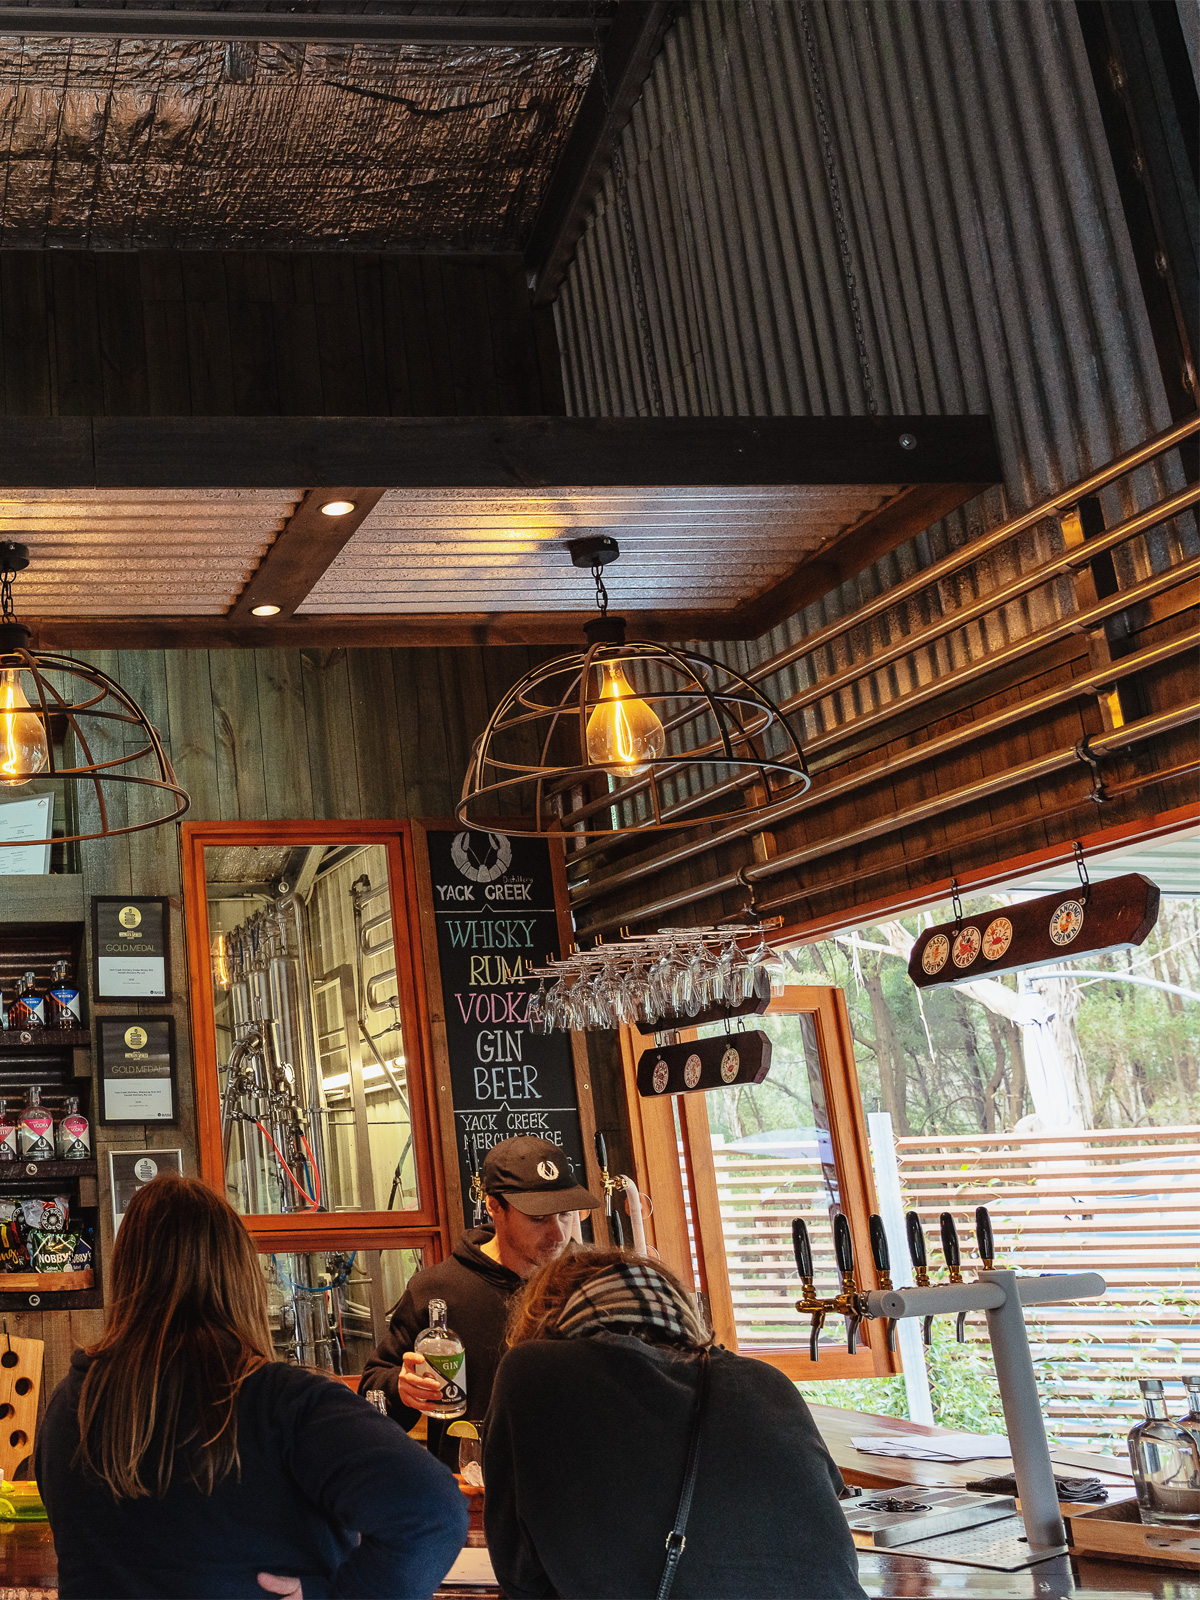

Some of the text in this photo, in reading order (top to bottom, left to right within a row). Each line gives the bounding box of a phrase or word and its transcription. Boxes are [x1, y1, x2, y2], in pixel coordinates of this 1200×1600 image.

[436, 885, 475, 901] YACK
[1053, 903, 1081, 924] PRANCING
[445, 920, 537, 948] WHISKY
[1054, 926, 1077, 941] PRAWN
[105, 943, 156, 952] GOLD MEDAL
[469, 955, 525, 986] RUM
[454, 992, 544, 1024] VODKA
[476, 1030, 524, 1063] GIN
[111, 1065, 161, 1073] GOLD MEDAL
[473, 1065, 542, 1100] BEER
[460, 1112, 549, 1131] YACK CREEK
[442, 1360, 459, 1370] GIN
